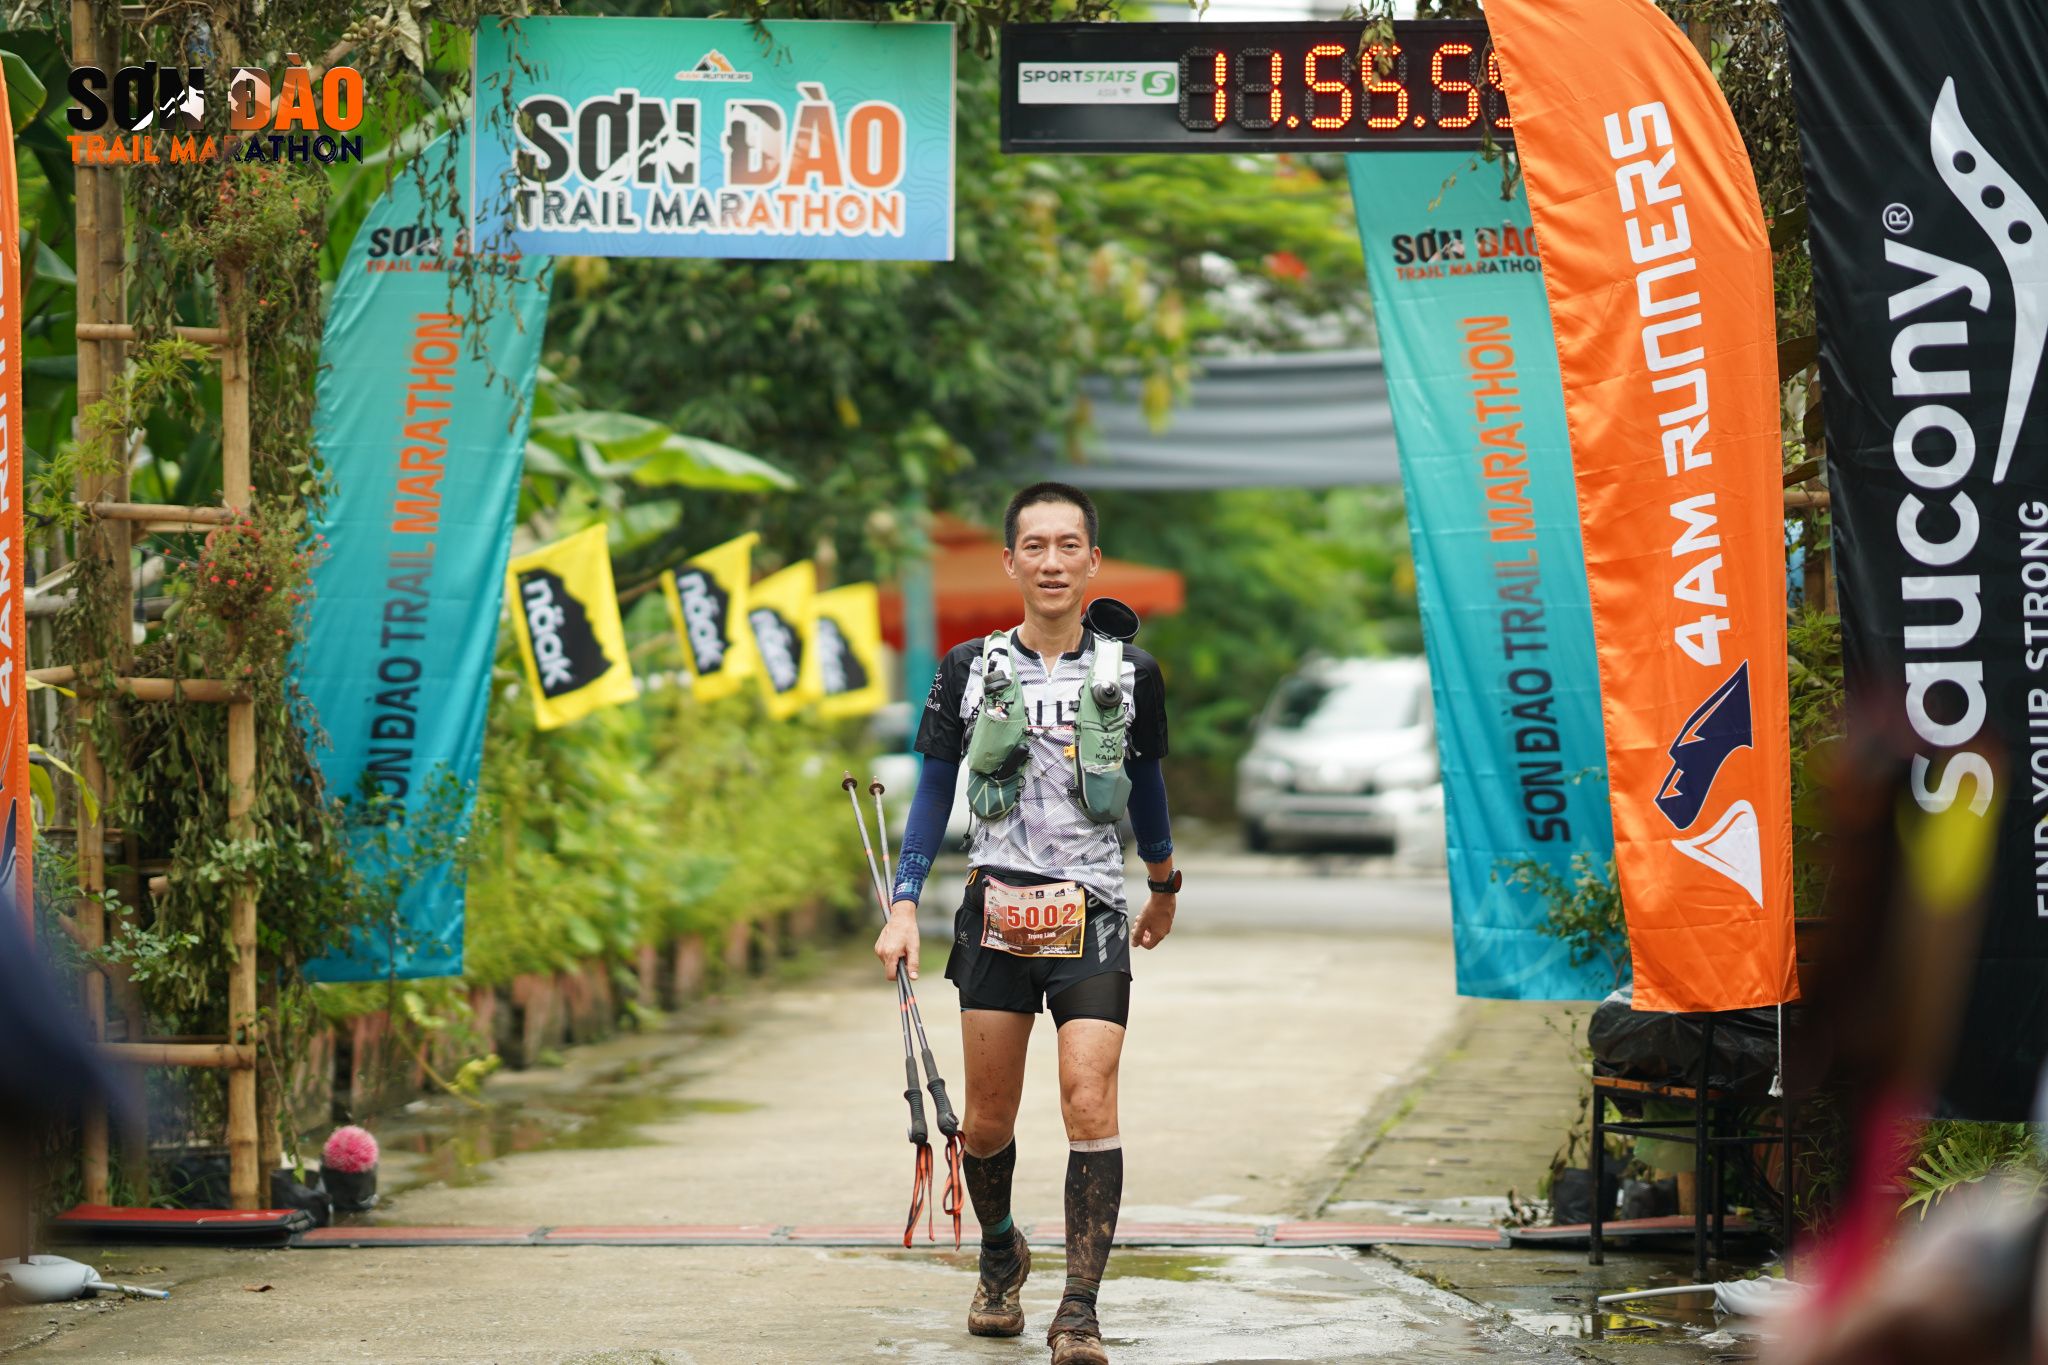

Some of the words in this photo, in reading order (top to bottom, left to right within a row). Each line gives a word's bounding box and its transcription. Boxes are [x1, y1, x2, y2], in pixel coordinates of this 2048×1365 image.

[1022, 70, 1137, 83] SPORTSTATS
[517, 92, 697, 185] SƠN
[726, 86, 902, 187] ĐÀO
[518, 190, 637, 228] TRAIL
[651, 190, 899, 230] MARATHON
[1391, 227, 1465, 265] SƠN
[366, 259, 413, 274] TRAIL
[1395, 264, 1444, 281] TRAIL
[1603, 101, 1713, 477] RUNNERS
[391, 312, 464, 533] MARATHON
[1462, 314, 1537, 542] MARATHON
[1671, 492, 1731, 667] 4AM
[1884, 238, 1994, 819] saucony
[380, 541, 436, 649] TRAIL
[523, 578, 573, 689] näak
[1494, 548, 1549, 661] TRAIL
[2018, 501, 2048, 671] STRONG
[365, 656, 422, 739] ĐÀO
[1501, 667, 1560, 753] ĐÀO
[1007, 903, 1078, 929] 5002
